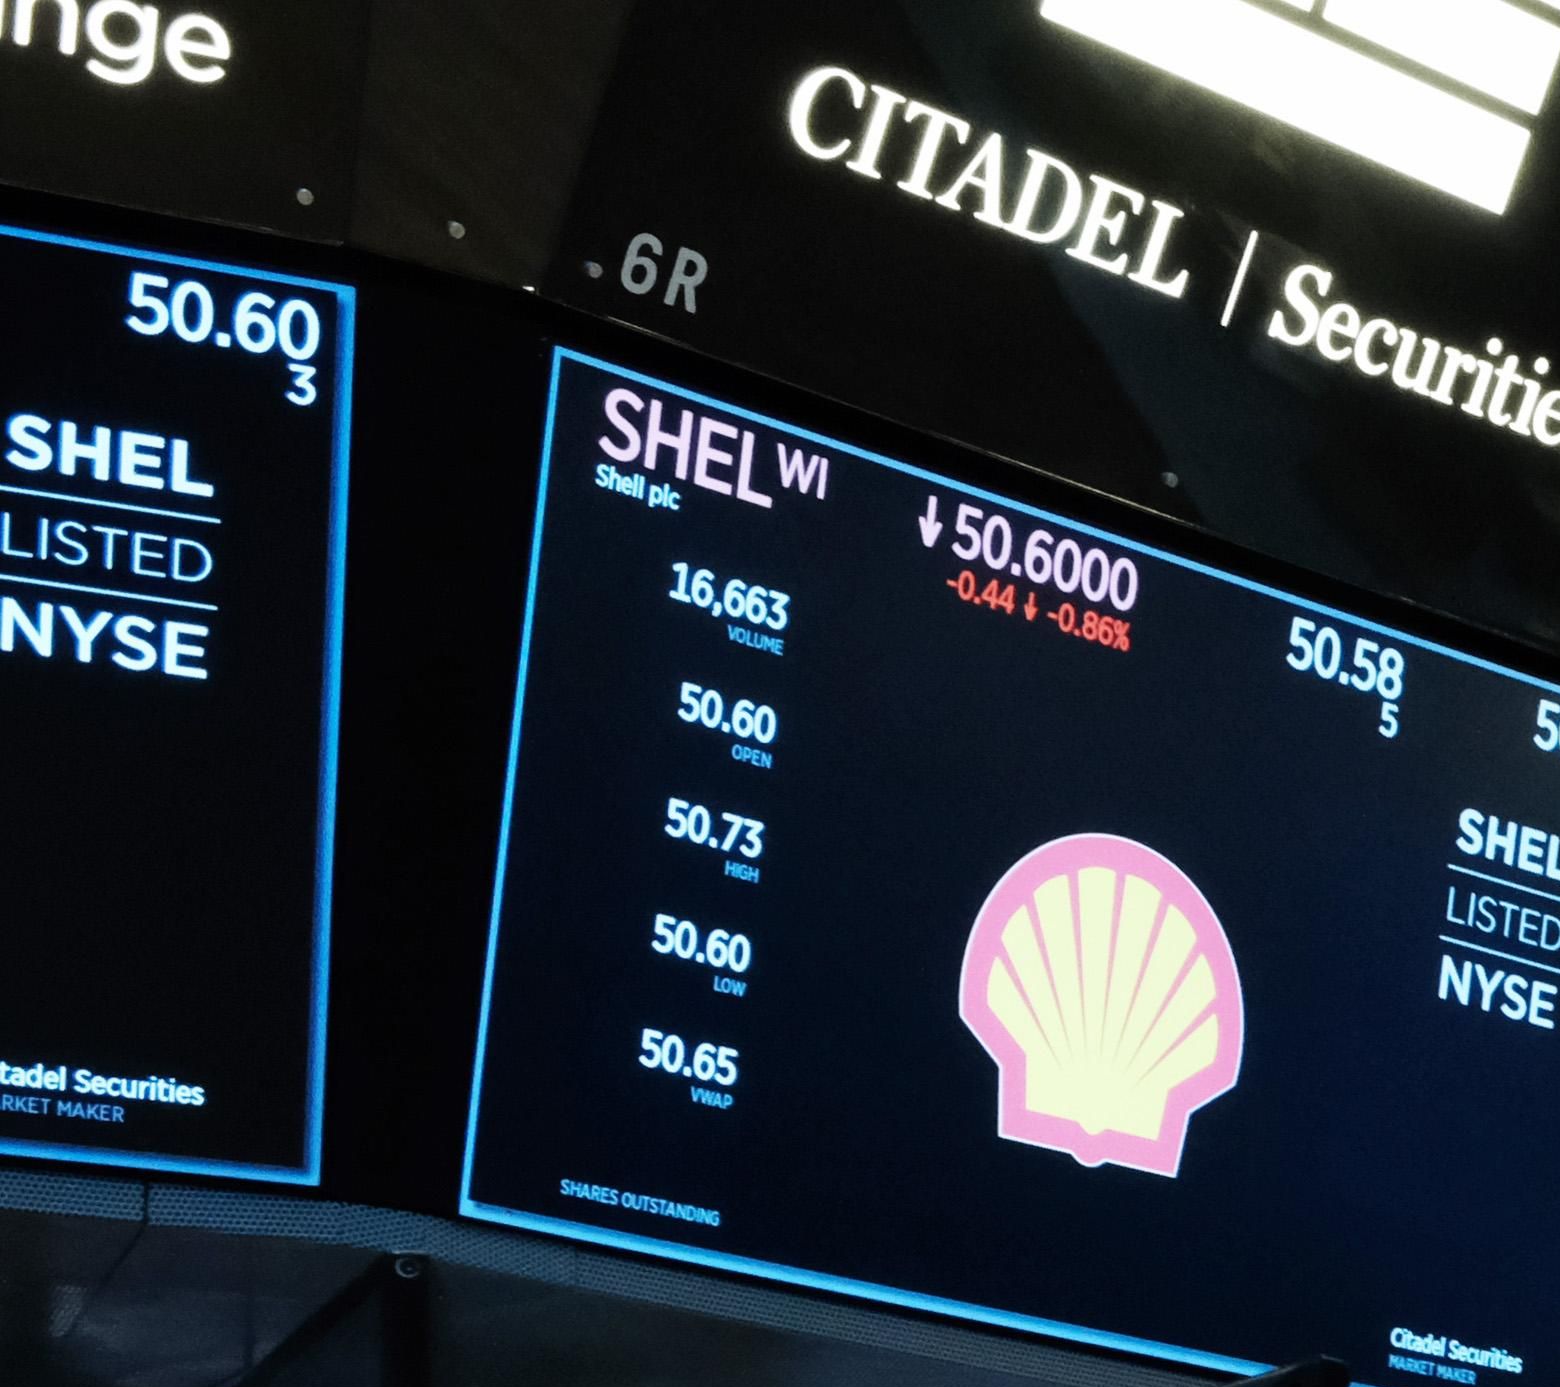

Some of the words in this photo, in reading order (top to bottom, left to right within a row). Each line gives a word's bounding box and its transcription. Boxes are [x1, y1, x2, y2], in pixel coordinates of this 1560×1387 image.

[0, 0, 233, 84] nge
[786, 64, 1192, 301] CITADEL
[619, 231, 709, 315] 6R
[124, 271, 321, 364] 50.60
[286, 362, 318, 408] 3
[3, 413, 214, 499] SHEL
[598, 387, 774, 509] SHEL
[777, 442, 831, 501] WI
[1, 519, 213, 585] LISTED
[951, 504, 1140, 613] 50.6000
[668, 561, 791, 631] 16,663
[945, 572, 1016, 619] -0.44
[1045, 603, 1131, 653] -0.86%
[0, 601, 210, 681] NYSE
[727, 624, 785, 657] VOLUME
[1285, 615, 1405, 702] 50.58
[677, 681, 777, 745] 50.60
[1377, 703, 1400, 740] 5
[731, 744, 773, 770] OPEN
[664, 797, 766, 859] 50.73
[724, 859, 760, 884] HIGH
[651, 912, 753, 974] 50.60
[713, 974, 748, 998] LOW
[1437, 953, 1559, 1031] NYSE
[73, 1069, 205, 1106] Securities
[638, 1027, 739, 1087] 50.65
[57, 1101, 125, 1123] MAKER
[559, 1178, 619, 1207] SHARES
[621, 1191, 721, 1229] OUTSTANDING
[1390, 1326, 1446, 1359] Citadel
[1448, 1339, 1524, 1374] Securities
